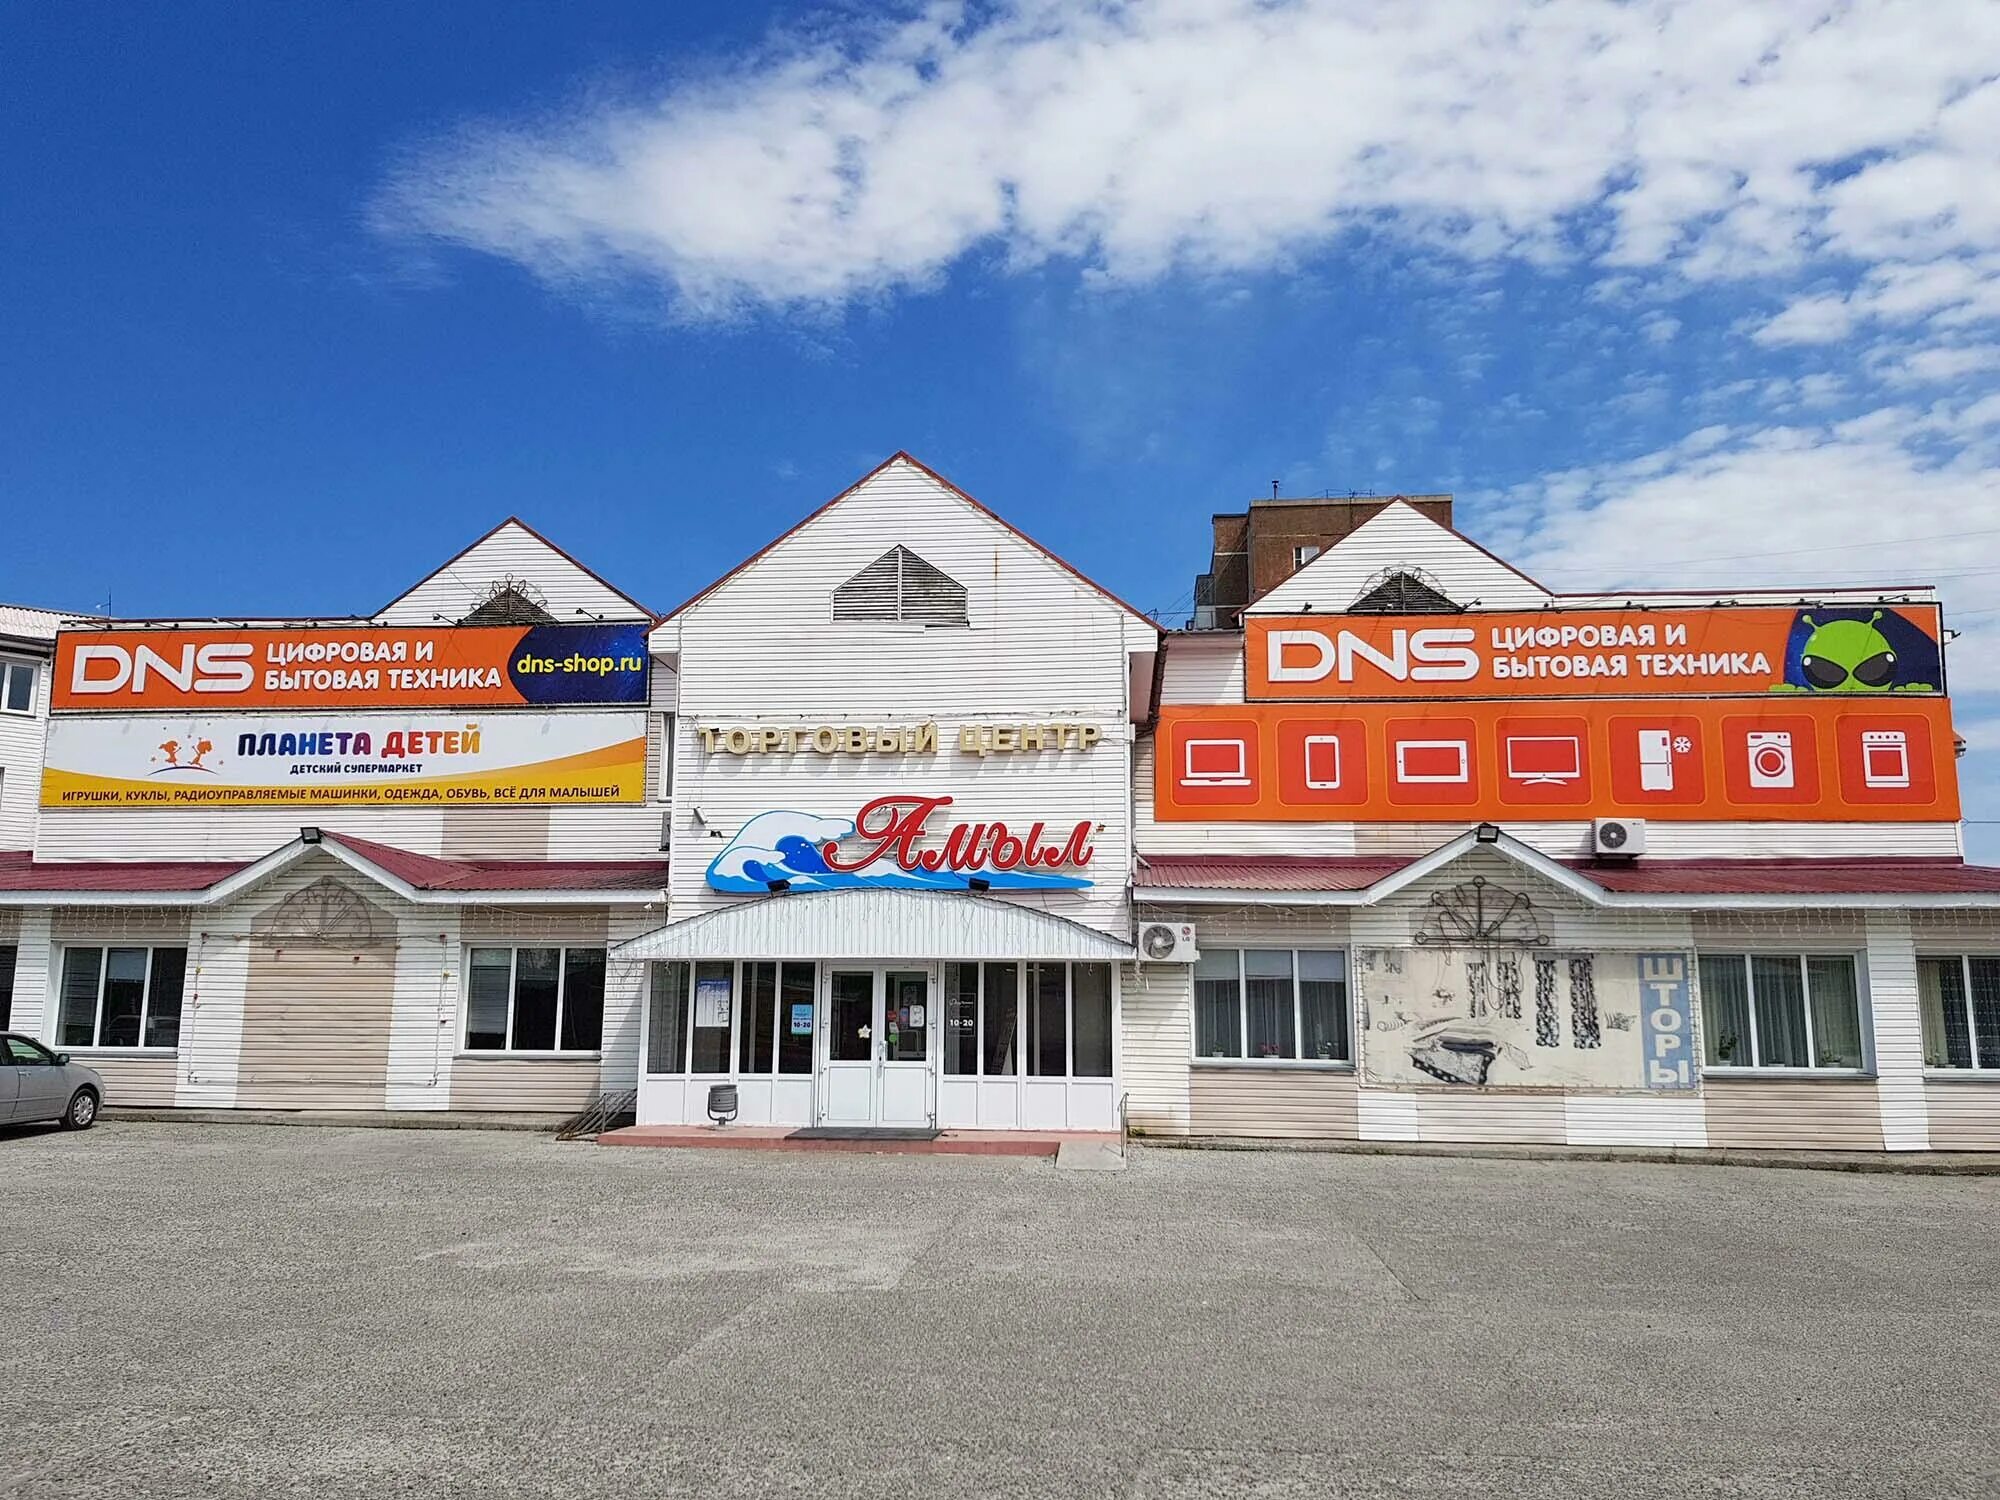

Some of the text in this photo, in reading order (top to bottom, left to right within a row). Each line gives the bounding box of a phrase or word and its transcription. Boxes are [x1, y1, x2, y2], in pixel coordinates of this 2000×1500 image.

[1491, 623, 1687, 652] ЦИФРОВАЯ И
[266, 641, 434, 666] ЦИФРОВАЯ И
[516, 653, 643, 676] dns-shop.ru
[1267, 628, 1480, 682] DNS
[1492, 651, 1771, 678] БЫТОВАЯ ТЕХНИКА
[71, 643, 255, 693] DNS
[264, 668, 502, 690] БЫТОВАЯ ТЕХНИКА
[237, 724, 481, 758] ПЛАНЕТА ДЕТЕЙ
[699, 719, 1102, 758] ТОРГОВЫЙ ЦЕНТР
[289, 761, 424, 775] ДЕТСКИЙ СУПЕРМАРКЕТ
[62, 785, 620, 802] ИГРУШКИ, КУКЛЫ, РАДИОУПРАВЛЯЕМЫЕ МАШИНКИ, ОДЕЖДА, ОБУВЬ, ВСЁ ДЛЯ МАЛЫШЕЙ
[822, 795, 1094, 873] Амыл
[949, 1019, 974, 1027] 10-20
[1643, 958, 1689, 1084] ШТОРЫ
